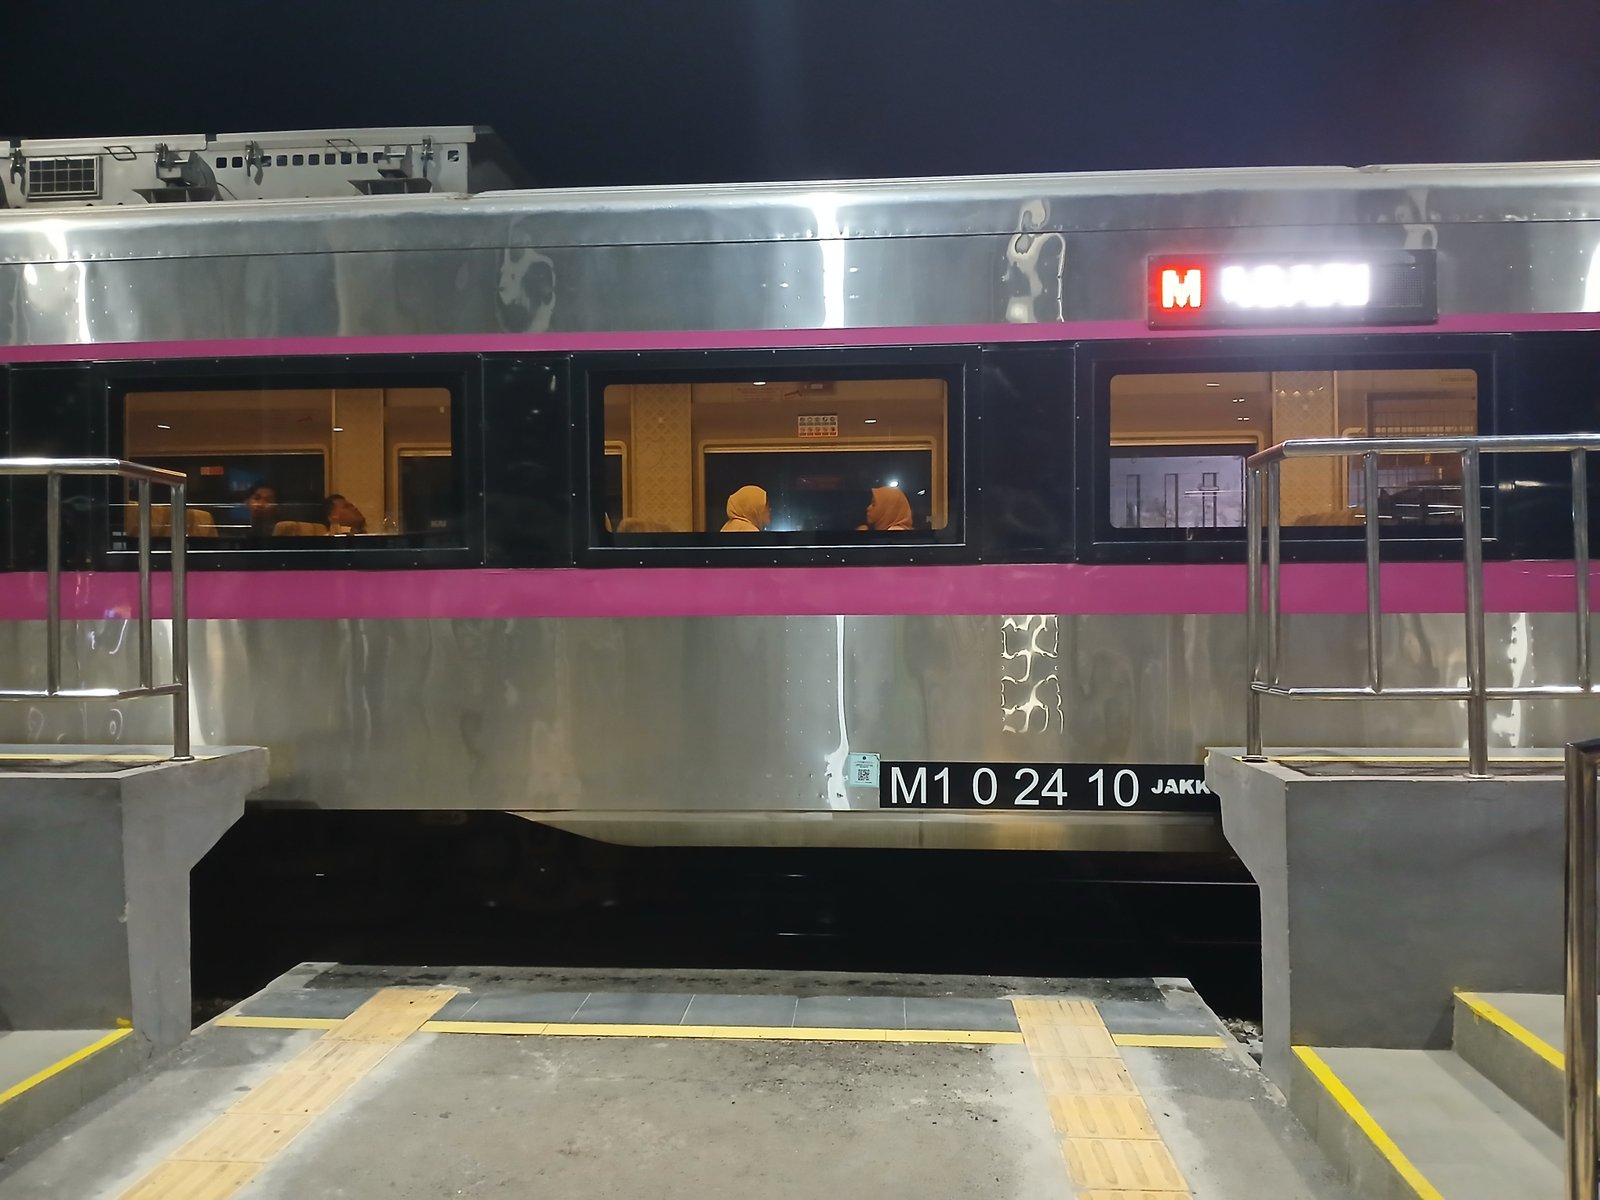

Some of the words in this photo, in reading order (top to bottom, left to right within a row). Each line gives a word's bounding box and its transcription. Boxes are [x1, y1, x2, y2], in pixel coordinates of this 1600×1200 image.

[1162, 269, 1201, 308] M
[891, 766, 949, 805] M1
[972, 767, 998, 806] 0
[1013, 767, 1068, 806] 24
[1088, 768, 1139, 807] 10
